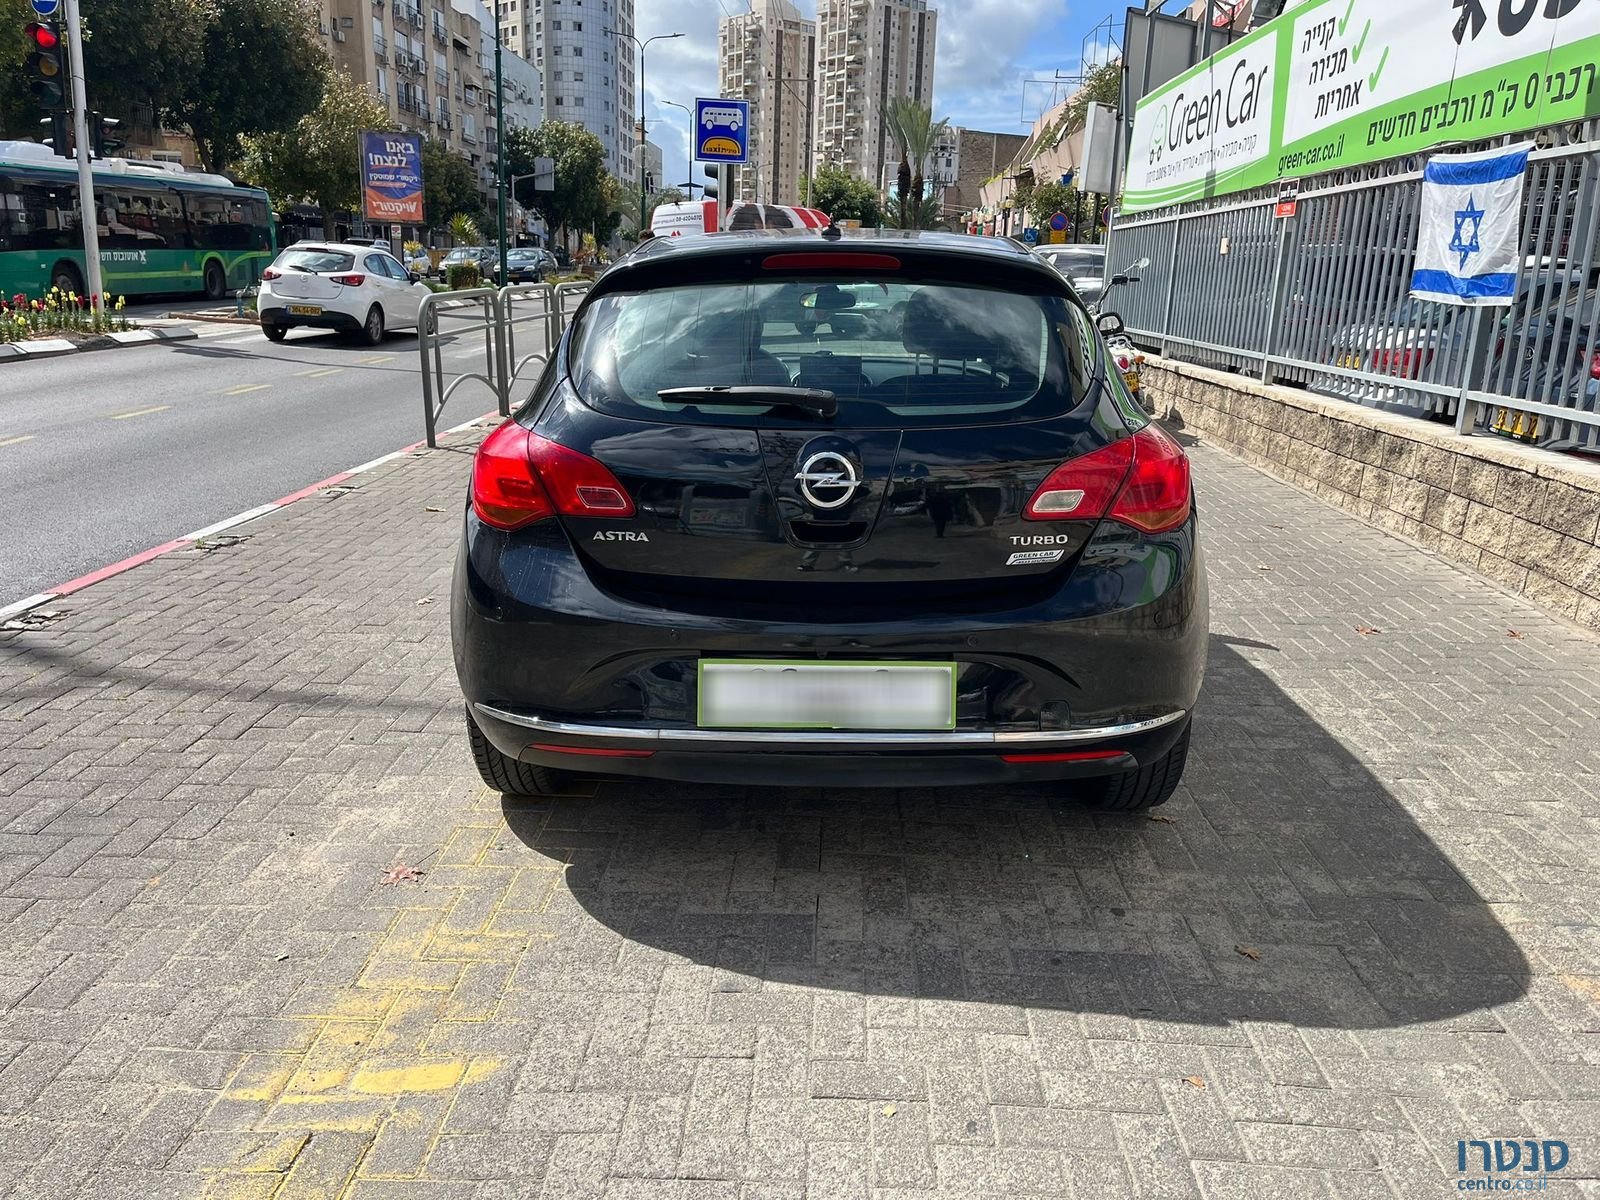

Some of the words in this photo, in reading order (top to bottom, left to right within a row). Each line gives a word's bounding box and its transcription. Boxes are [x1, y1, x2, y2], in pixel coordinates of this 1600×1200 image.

[1302, 17, 1336, 53] קנייה
[1309, 48, 1348, 85] מכירה
[1545, 63, 1596, 104] רכבי
[1168, 88, 1221, 151] Green
[1226, 59, 1268, 128] Car
[1314, 79, 1363, 119] אחריות
[1420, 94, 1476, 133] ורכבים
[1367, 111, 1416, 146] חדשים
[368, 152, 407, 167] לנצח!
[385, 141, 415, 154] באנו
[1278, 134, 1345, 176] green-car.co.il
[113, 251, 138, 261] אוטובוס
[592, 530, 650, 542] ASTRA
[1009, 534, 1068, 546] TURBO
